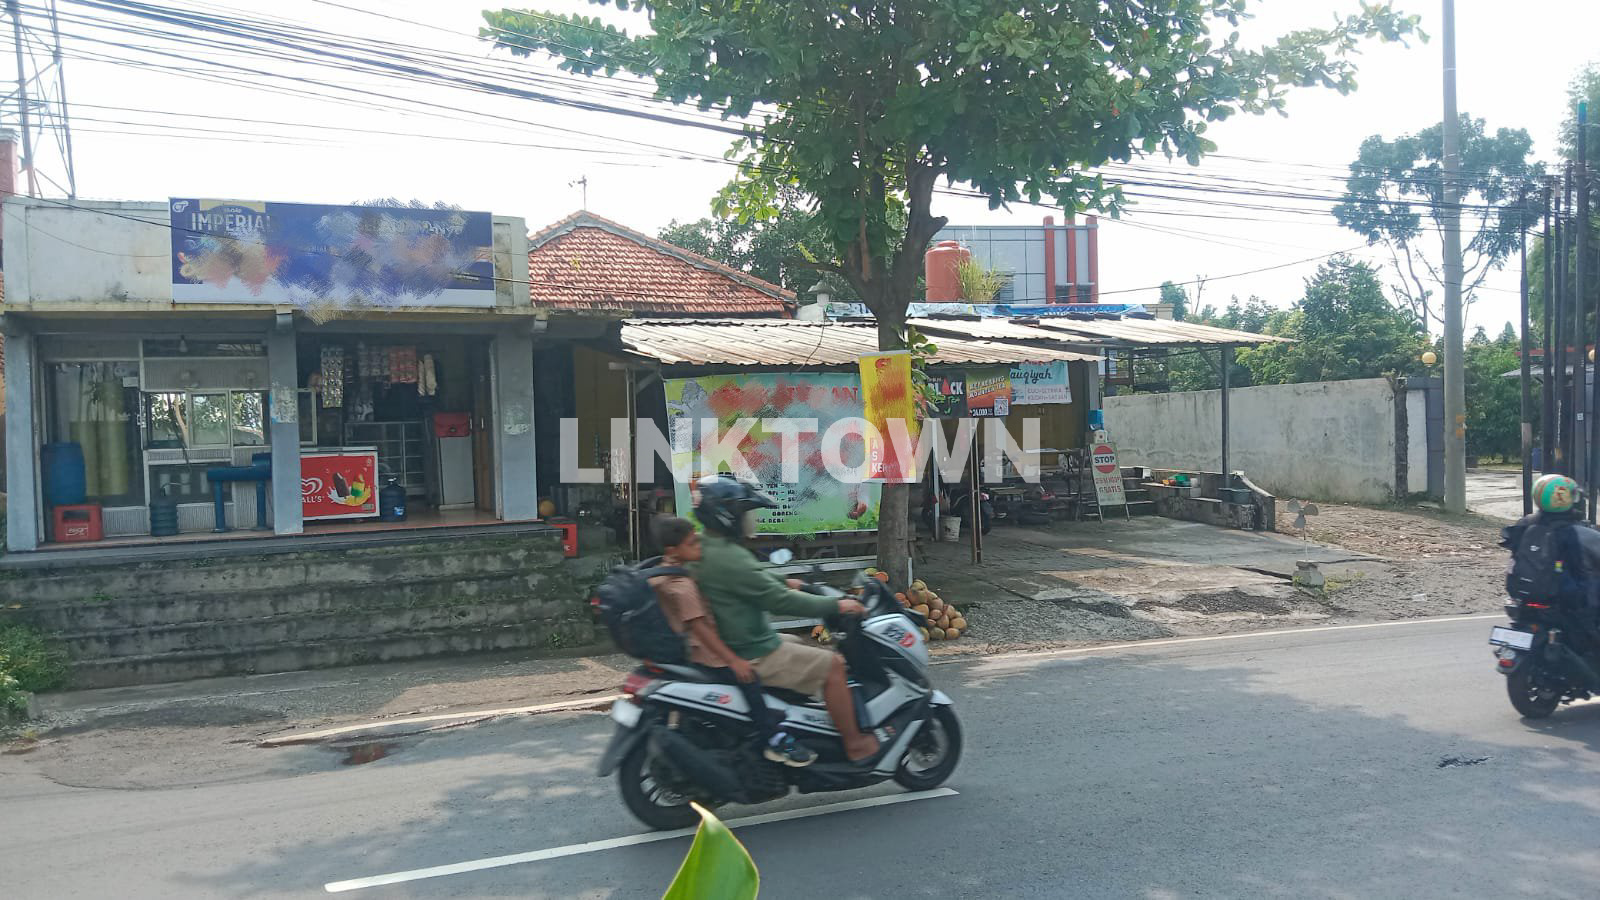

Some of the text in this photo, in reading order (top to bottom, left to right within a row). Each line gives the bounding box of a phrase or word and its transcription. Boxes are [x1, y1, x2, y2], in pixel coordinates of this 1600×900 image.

[1010, 368, 1053, 384] auqiyah
[1095, 455, 1115, 464] STOP
[302, 495, 323, 503] ALL'S
